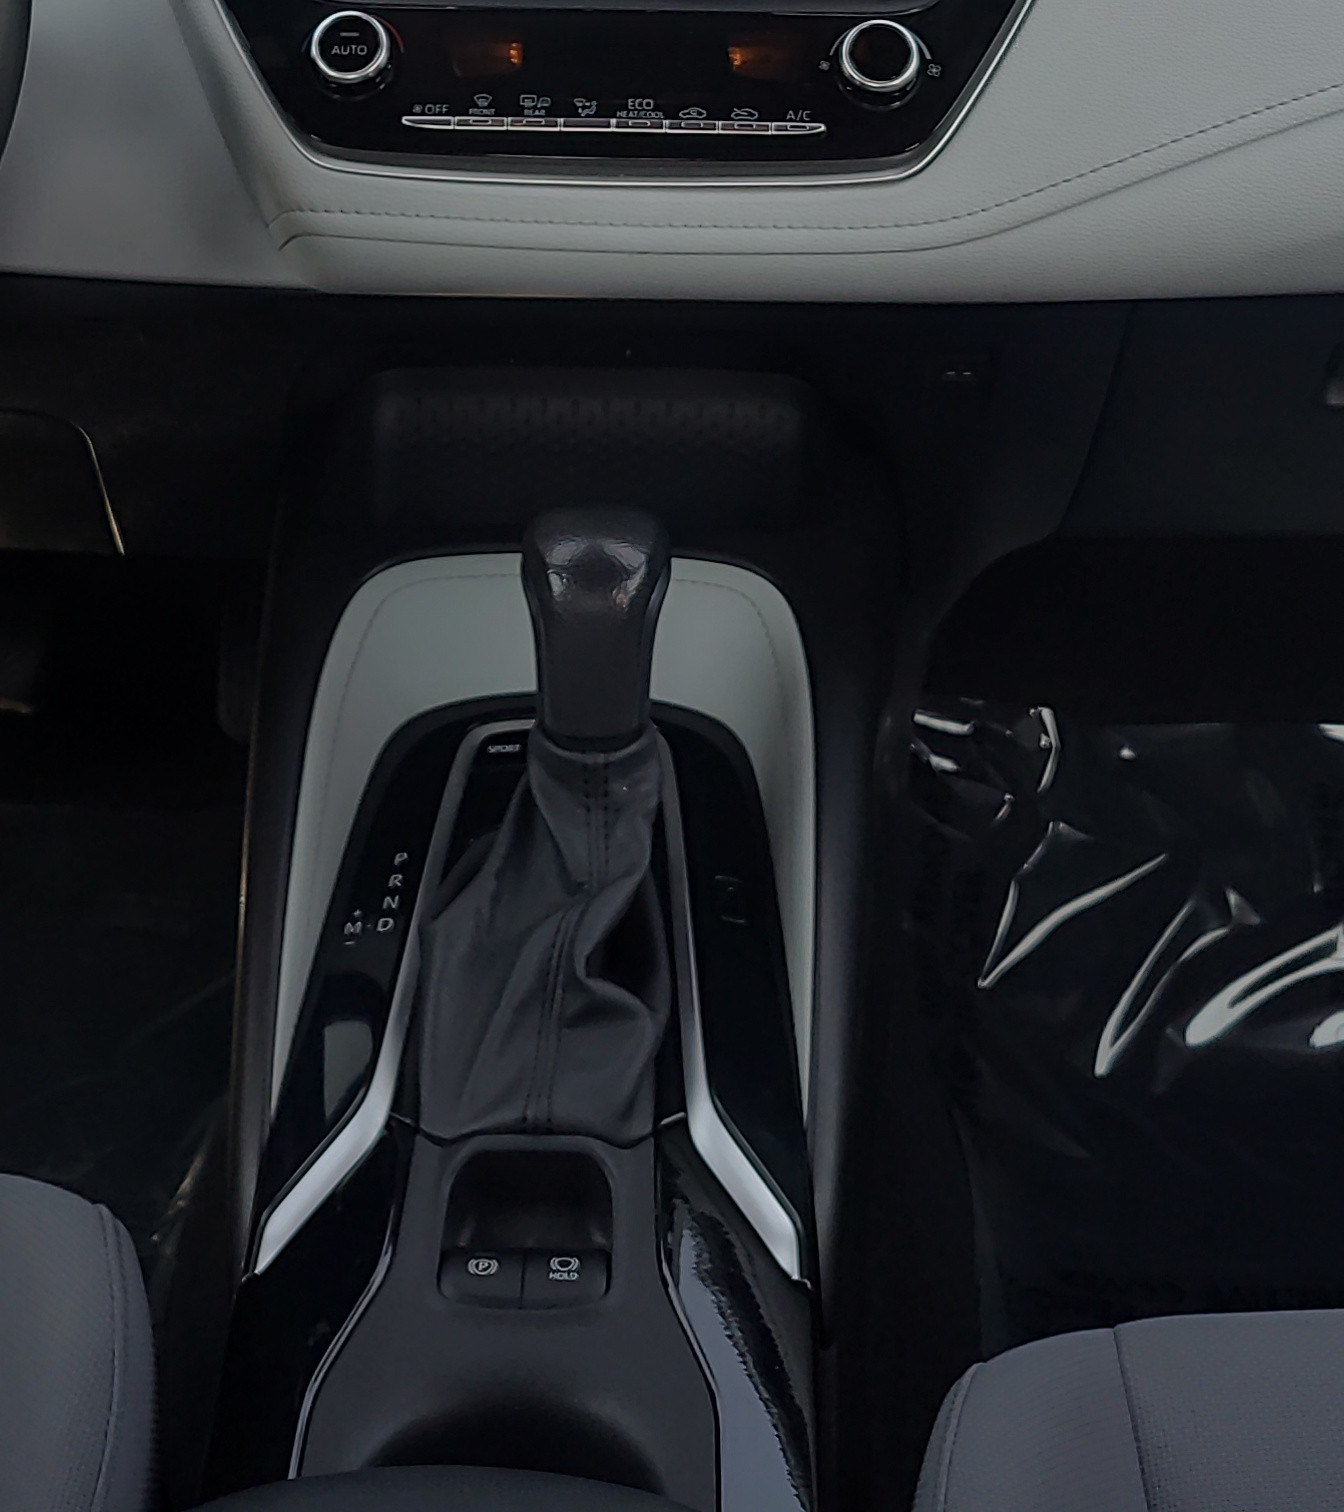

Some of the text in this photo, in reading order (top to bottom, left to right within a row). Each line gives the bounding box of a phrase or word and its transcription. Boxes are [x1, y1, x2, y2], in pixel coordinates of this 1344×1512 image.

[331, 44, 368, 56] AUTO
[424, 104, 449, 115] OFF
[627, 98, 654, 110] ECO
[469, 108, 496, 116] FRONT
[786, 110, 811, 121] A/C
[394, 852, 408, 866] P
[388, 874, 404, 887] R
[382, 894, 399, 909] N
[343, 921, 362, 935] M
[376, 917, 395, 932] D
[548, 1271, 580, 1281] HOLD
